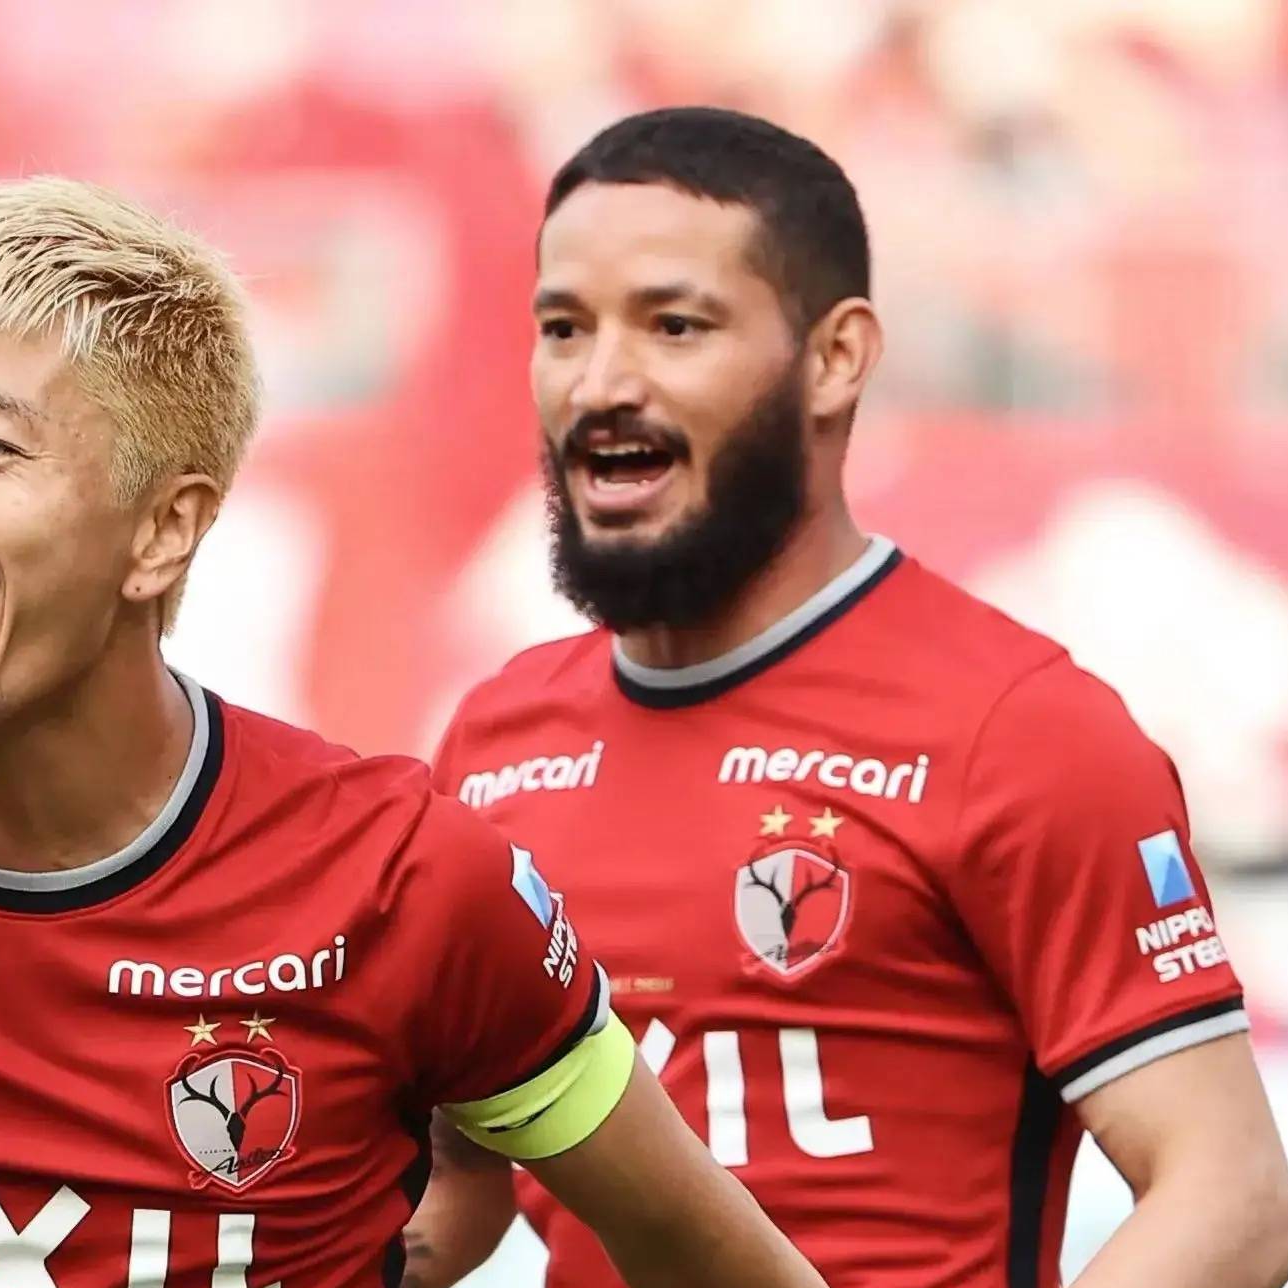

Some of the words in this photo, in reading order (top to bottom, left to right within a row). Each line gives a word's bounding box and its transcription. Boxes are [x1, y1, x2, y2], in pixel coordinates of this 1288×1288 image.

[459, 740, 604, 810] mercari
[717, 746, 929, 803] mercari
[108, 935, 345, 997] mercari
